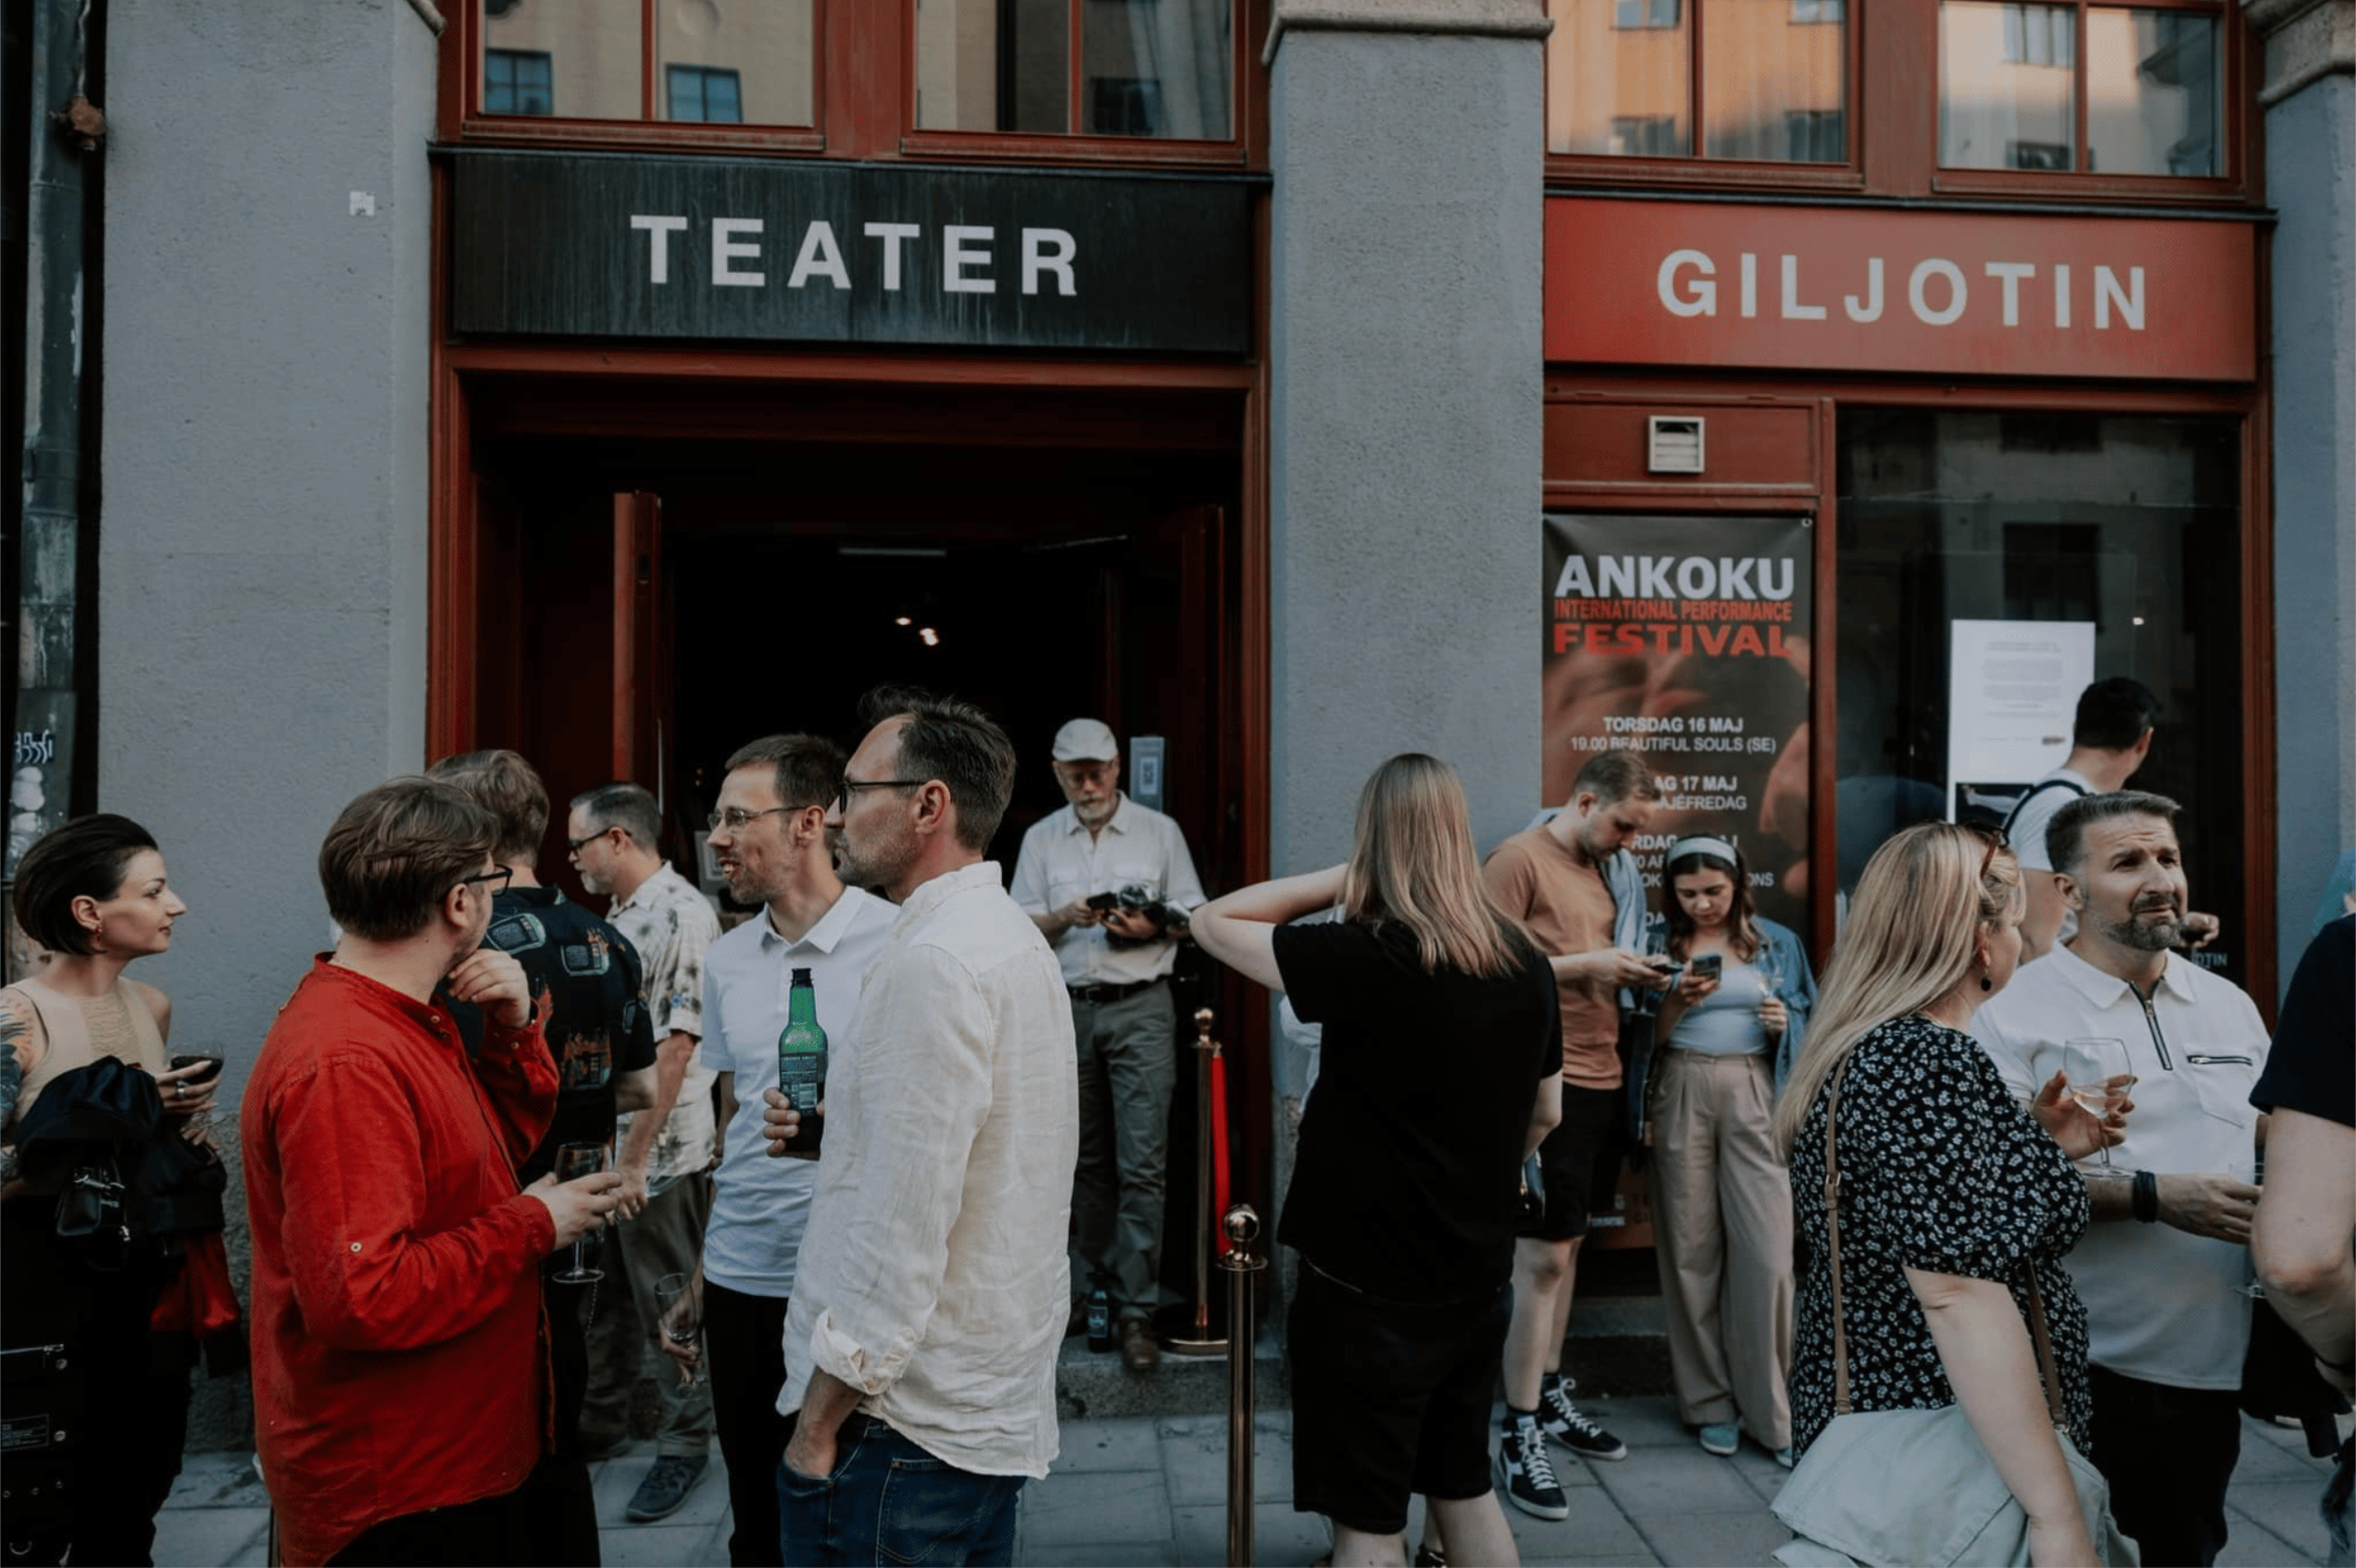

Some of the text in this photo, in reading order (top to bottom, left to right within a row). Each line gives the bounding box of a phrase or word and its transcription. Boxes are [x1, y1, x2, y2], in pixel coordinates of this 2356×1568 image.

[631, 214, 1078, 296] TEATER
[1657, 248, 2146, 331] GILJOTIN
[1554, 555, 1794, 599] ANKOKU
[1554, 599, 1793, 621] INTERNATIONAL PERFORMANCE
[1553, 624, 1792, 656] FESTIVAL
[1603, 716, 1744, 734] TORSDAG 16 MAJ
[1571, 737, 1777, 755] 19.00 BEAUTIFUL SOULS (SE)
[1681, 775, 1700, 791] 17
[1702, 775, 1738, 791] MAJ
[1631, 835, 1677, 849] RDAG
